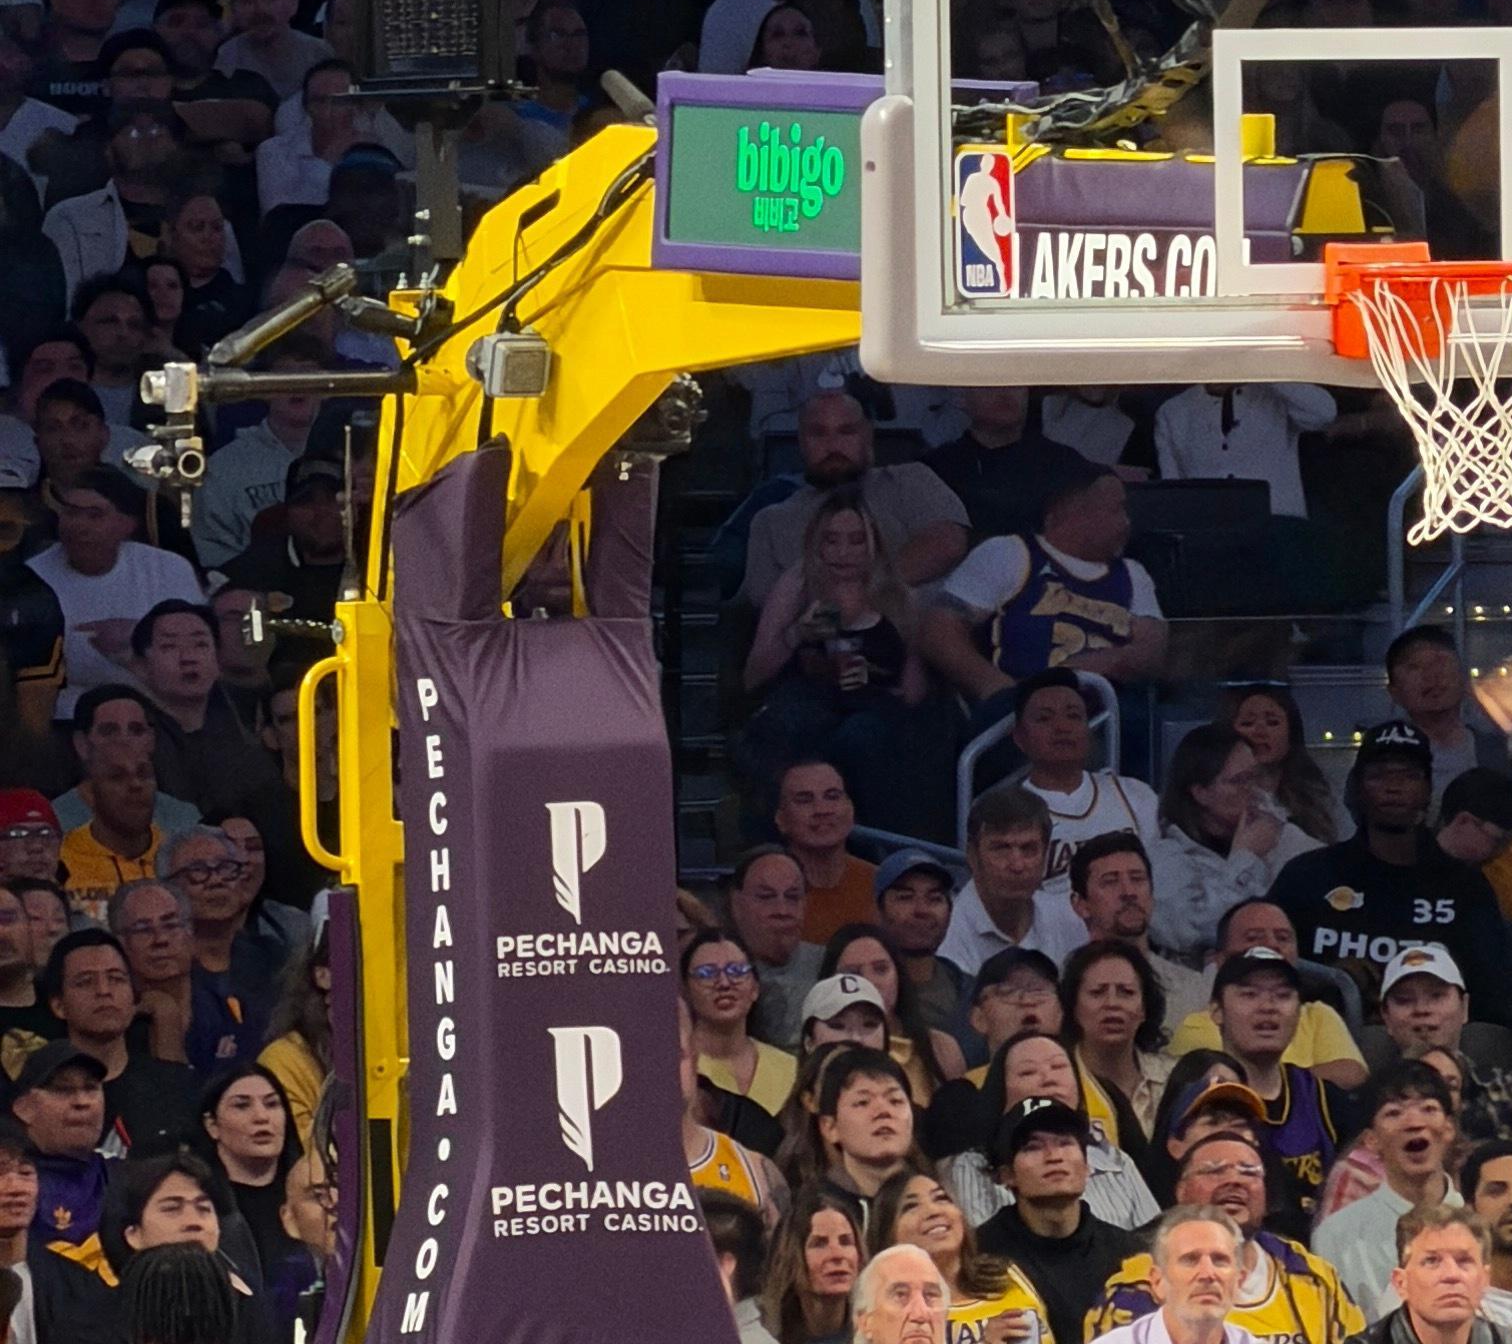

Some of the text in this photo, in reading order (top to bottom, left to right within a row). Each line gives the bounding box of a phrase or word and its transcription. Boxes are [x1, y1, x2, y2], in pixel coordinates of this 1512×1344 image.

[737, 121, 845, 218] bibigo
[965, 263, 994, 288] NBA
[1412, 897, 1457, 926] 35
[497, 931, 663, 959] PECHANGA
[1312, 926, 1450, 964] PHO
[498, 959, 578, 978] RESORT
[491, 1180, 695, 1216] PECHANGA
[494, 1213, 590, 1238] RESORT
